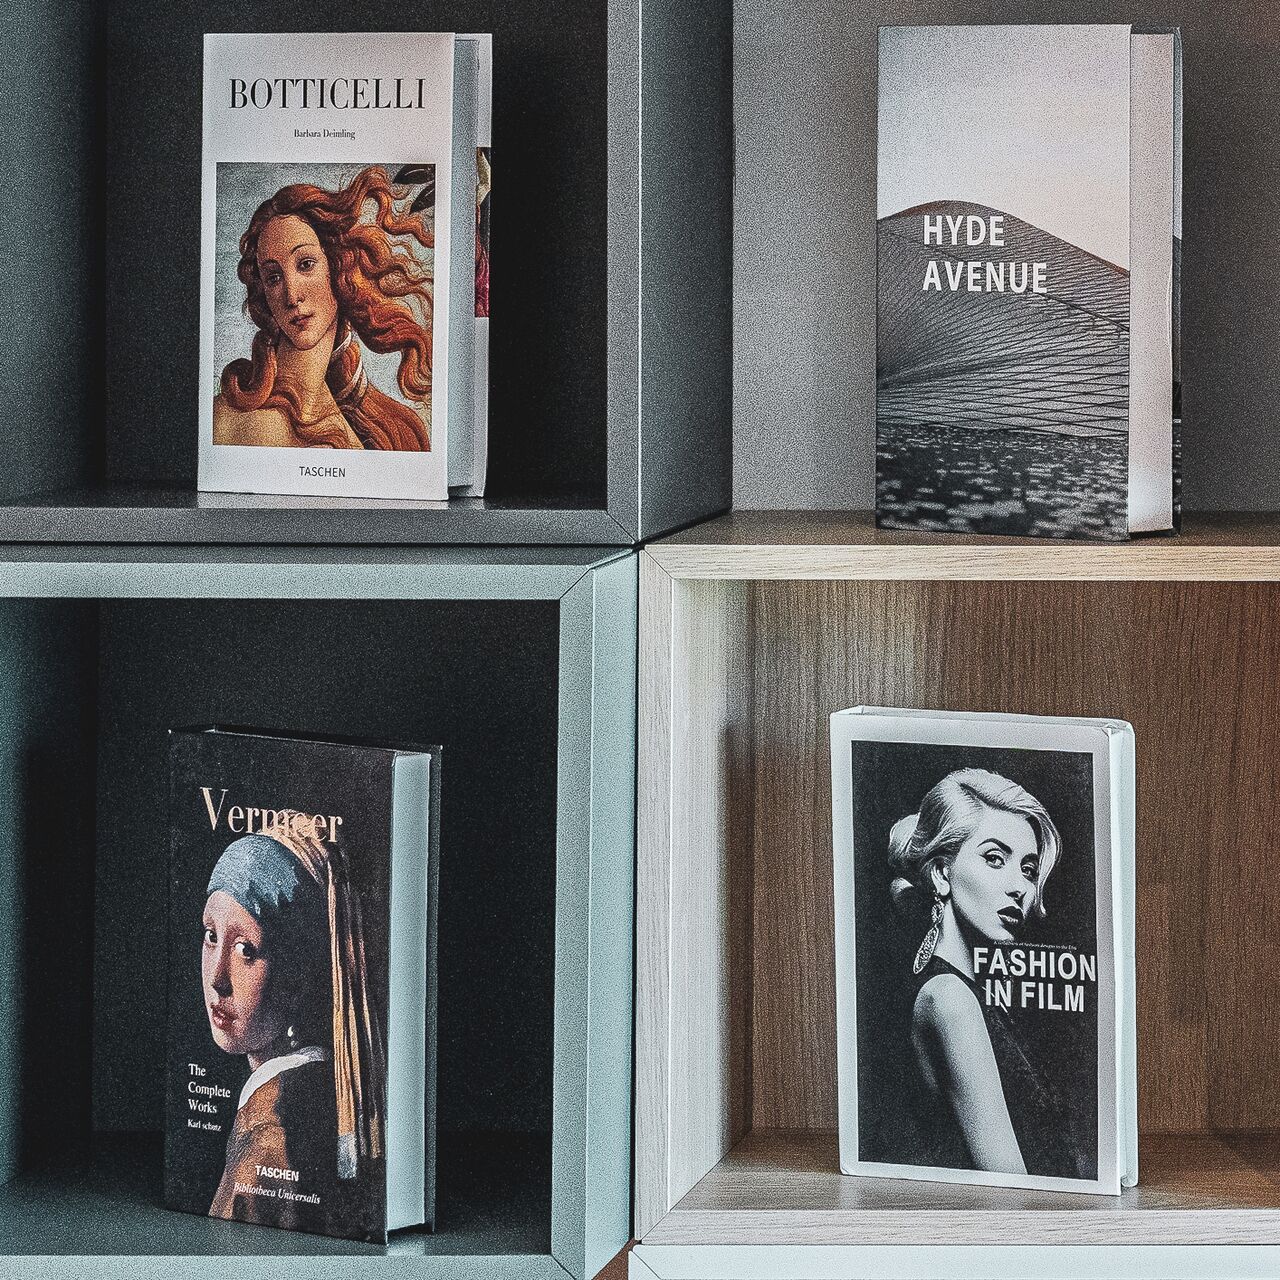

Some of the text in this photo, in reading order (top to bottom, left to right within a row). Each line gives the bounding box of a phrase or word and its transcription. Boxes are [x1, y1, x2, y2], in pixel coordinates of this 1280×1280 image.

[228, 78, 426, 109] BOTTICELLI
[294, 129, 356, 140] Barbara Deimling
[922, 215, 1005, 246] HYDE
[922, 261, 1047, 294] AVENUE
[299, 466, 346, 478] TASCHEN
[200, 786, 343, 842] Vermeer
[973, 947, 1096, 982] FASHION
[985, 978, 1084, 1012] IN FILM
[188, 1063, 206, 1077] The
[188, 1081, 231, 1099] Complete
[188, 1099, 218, 1114] Works
[187, 1119, 201, 1129] Karl
[255, 1165, 299, 1182] TASCHEN
